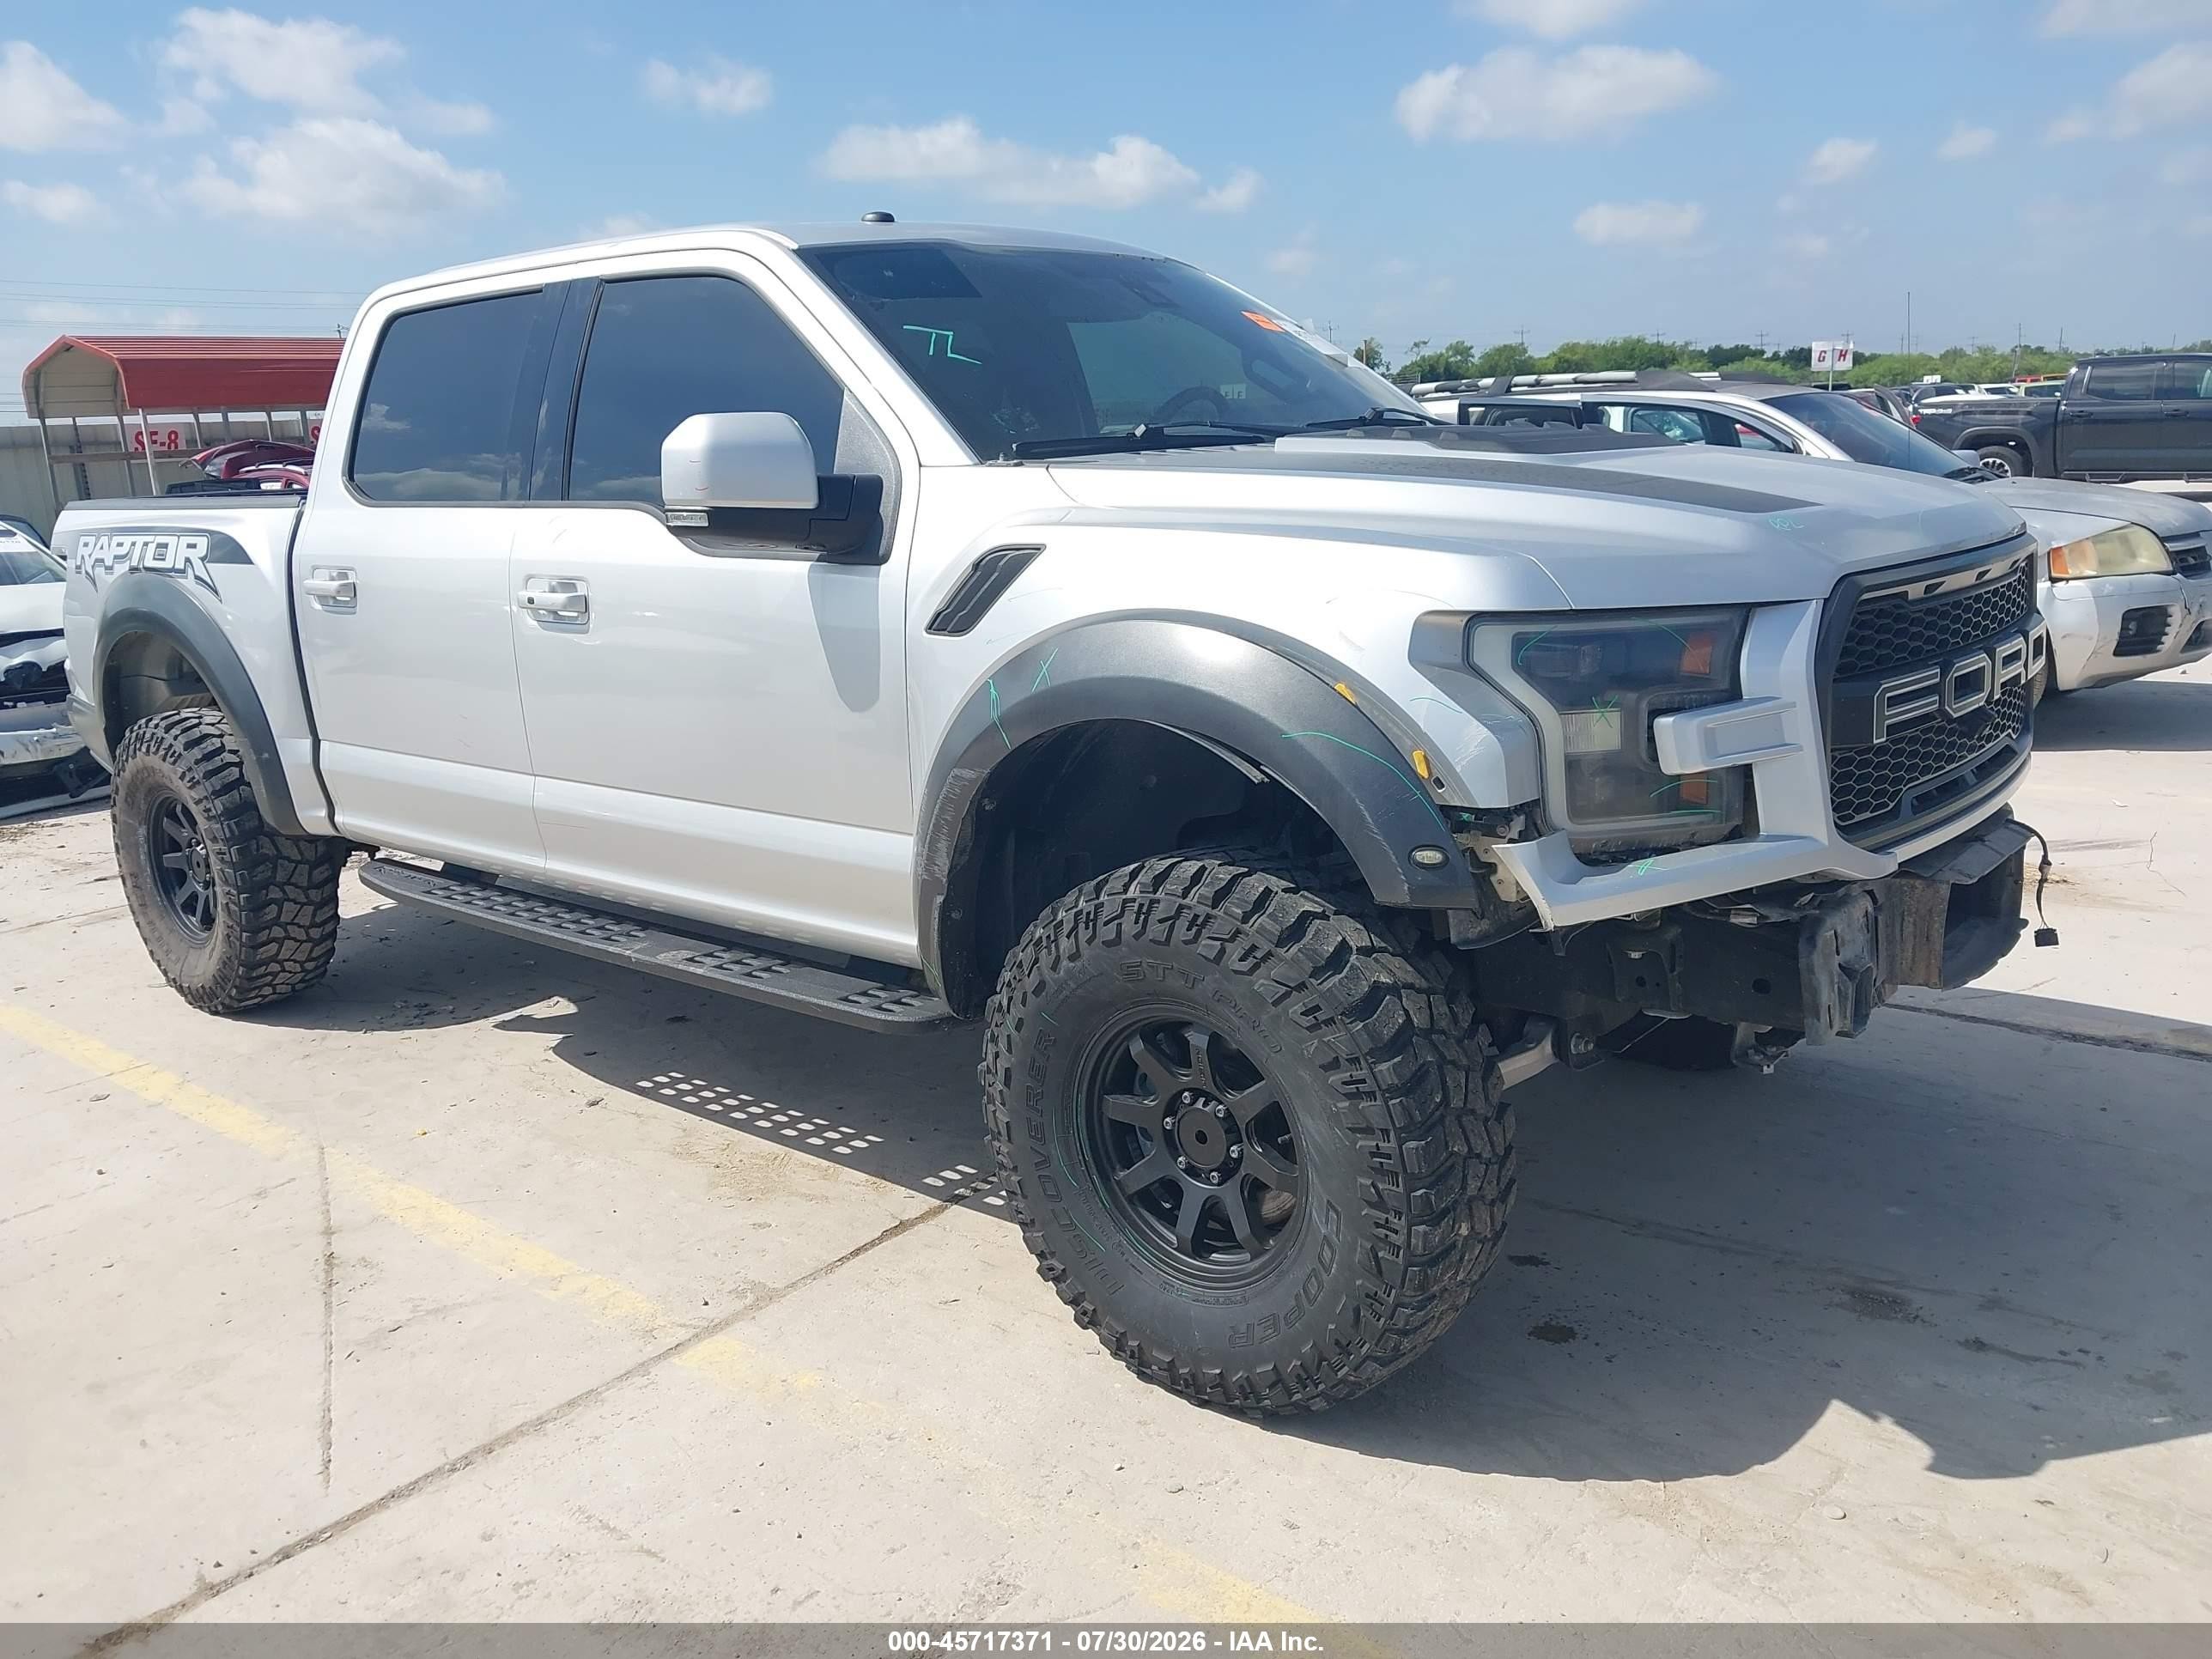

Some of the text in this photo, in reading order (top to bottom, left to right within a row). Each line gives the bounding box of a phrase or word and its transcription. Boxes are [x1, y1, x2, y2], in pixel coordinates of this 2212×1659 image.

[1817, 349, 1848, 362] G H
[76, 532, 222, 604] RAPTOR
[1874, 618, 2047, 744] FORD
[1120, 959, 1206, 990] STT
[1228, 1200, 1342, 1349] COOPER
